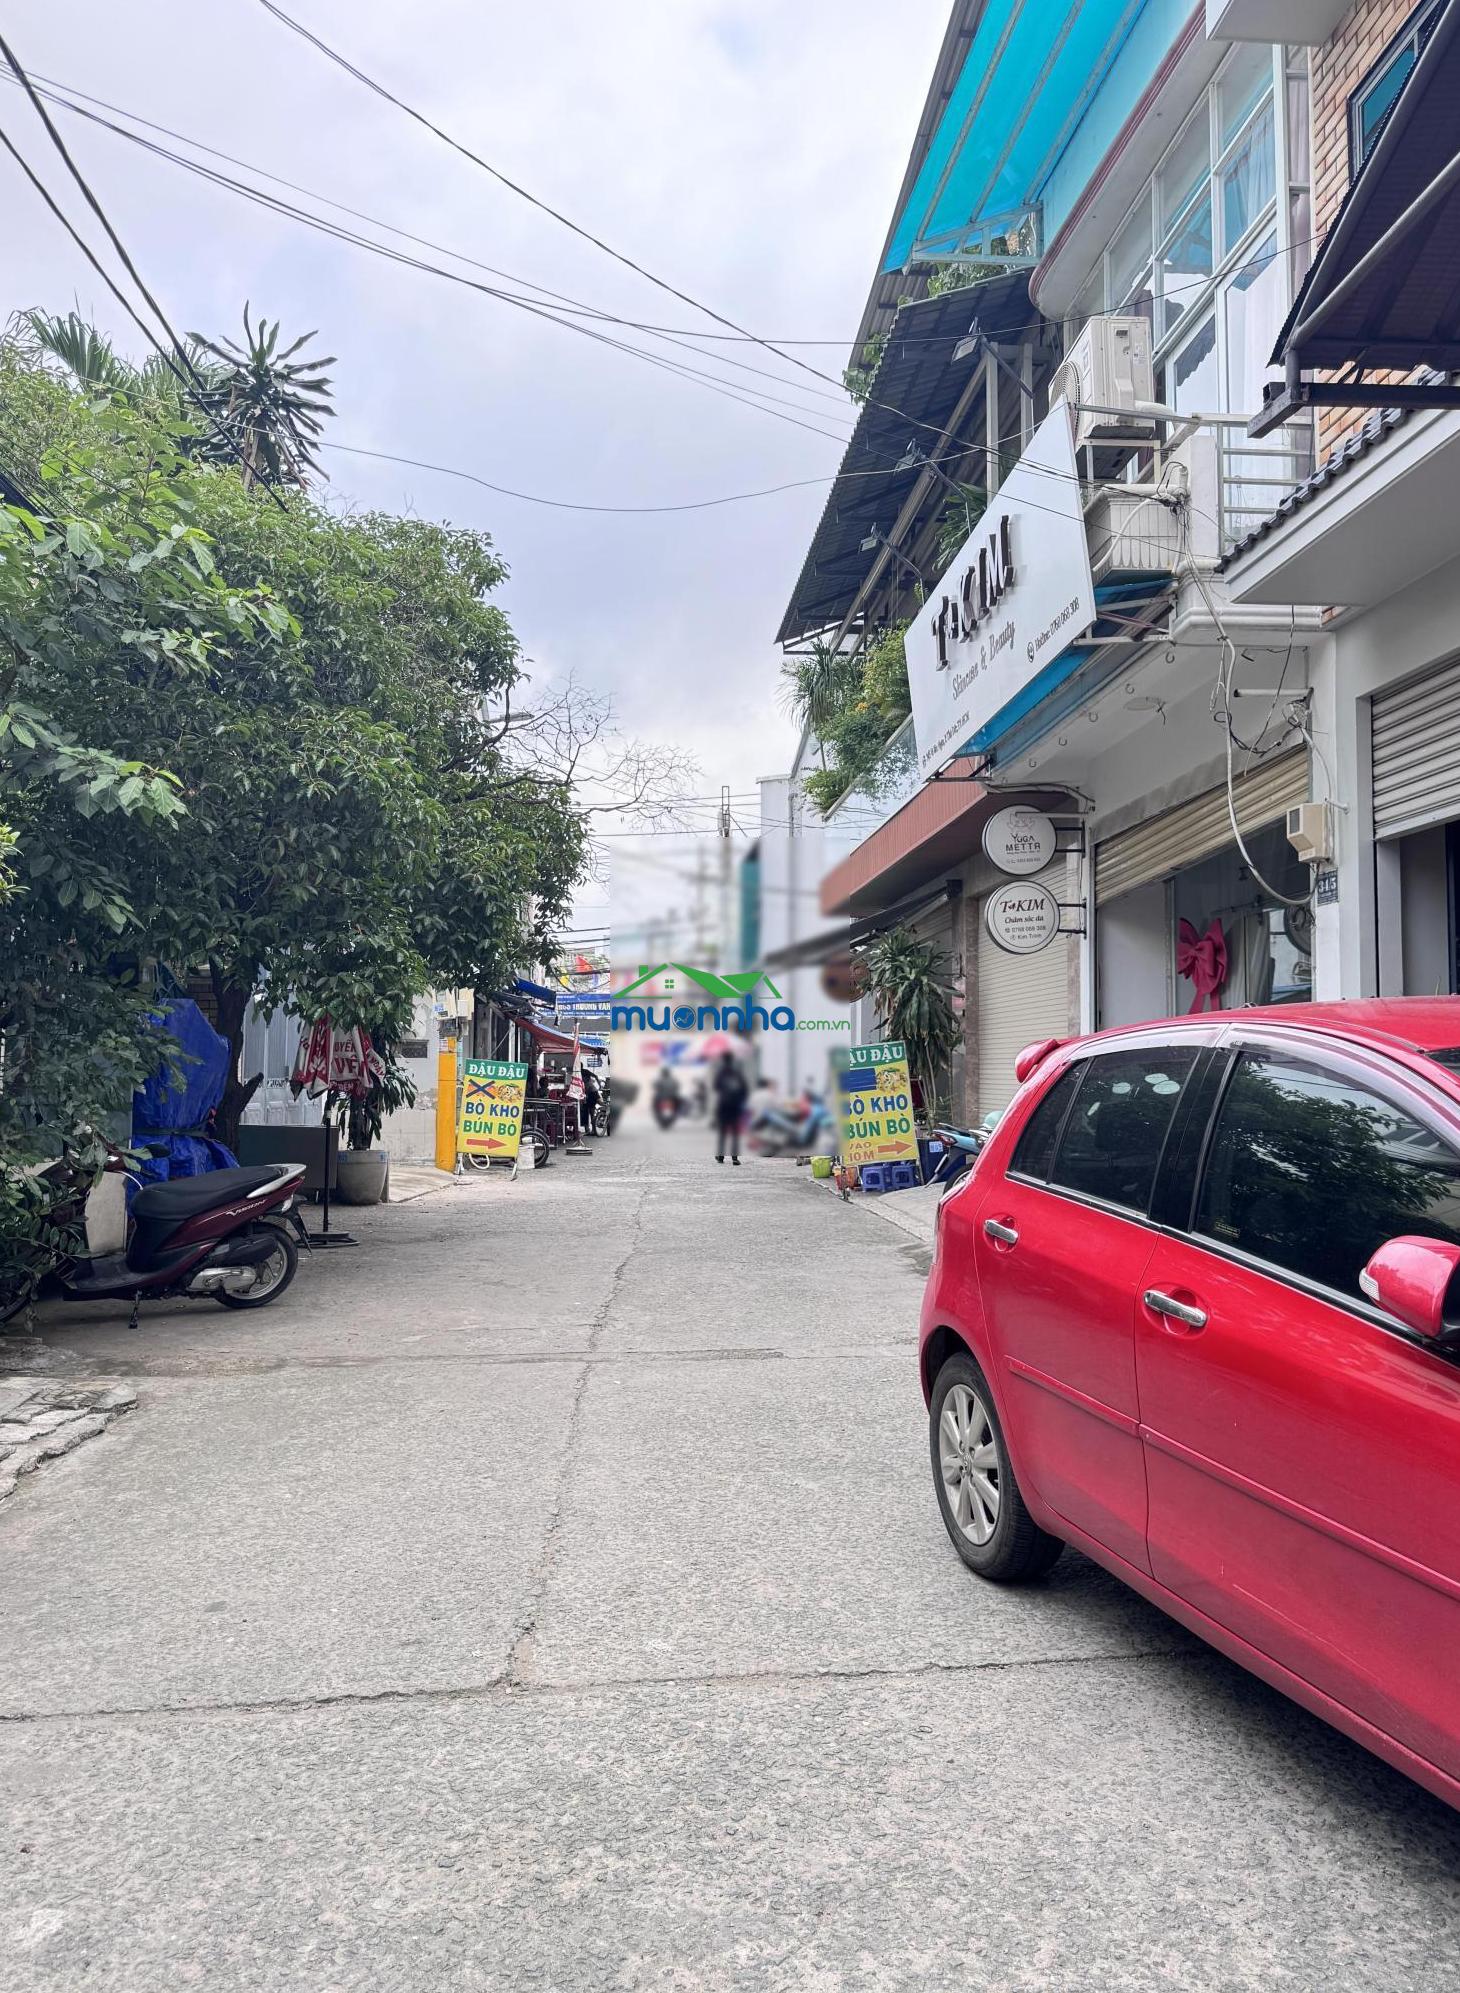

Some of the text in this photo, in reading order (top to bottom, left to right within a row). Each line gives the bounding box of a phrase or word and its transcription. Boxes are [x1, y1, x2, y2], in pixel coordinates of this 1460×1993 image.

[871, 1044, 903, 1063] ĐẬU
[469, 1062, 525, 1080] ĐẬU ĐẬU
[465, 1099, 520, 1118] BÒ KHO
[870, 1094, 908, 1113] KHO
[463, 1117, 517, 1136] BÚN BÒ
[885, 1113, 911, 1135] BÒ
